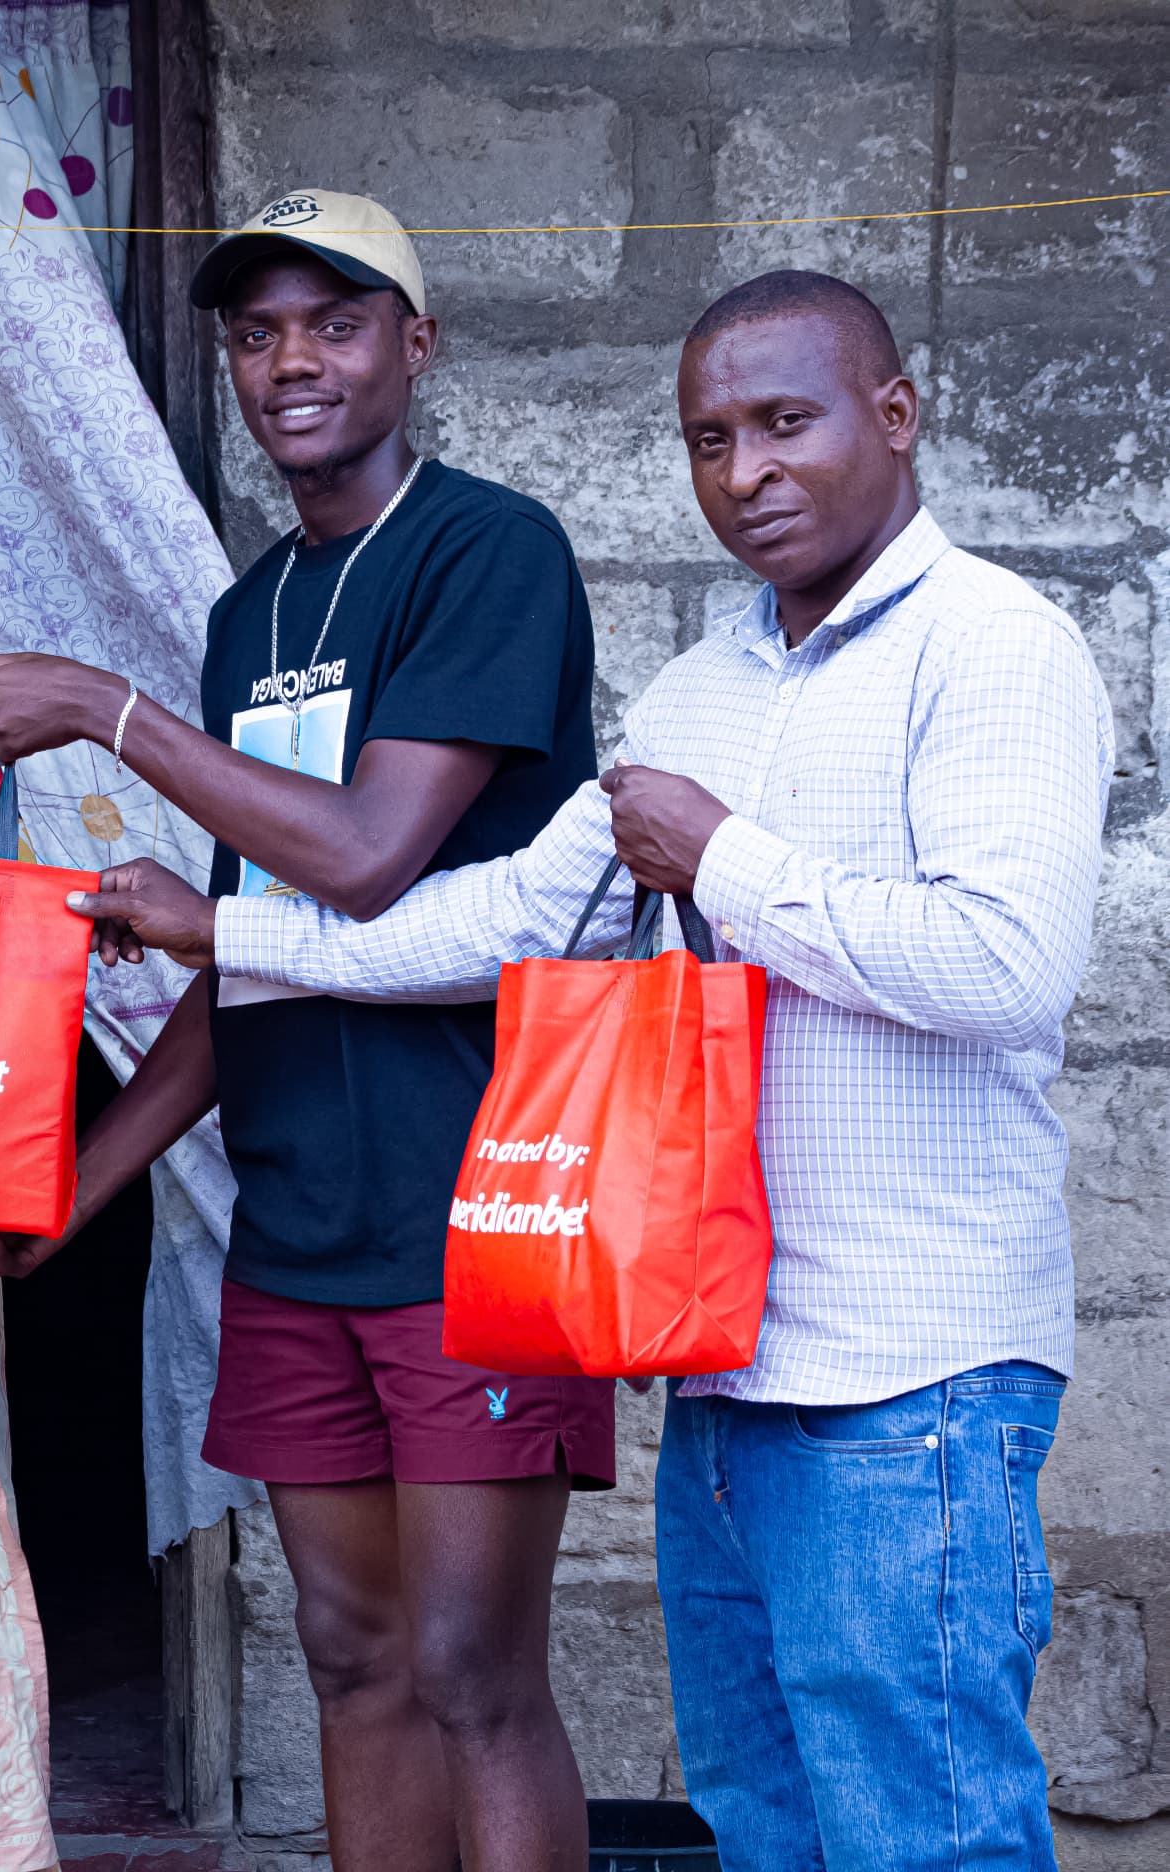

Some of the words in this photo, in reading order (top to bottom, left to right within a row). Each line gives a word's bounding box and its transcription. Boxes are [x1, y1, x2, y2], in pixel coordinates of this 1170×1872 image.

[262, 202, 325, 226] BULL
[476, 1133, 550, 1163] nated
[545, 1133, 591, 1172] by:
